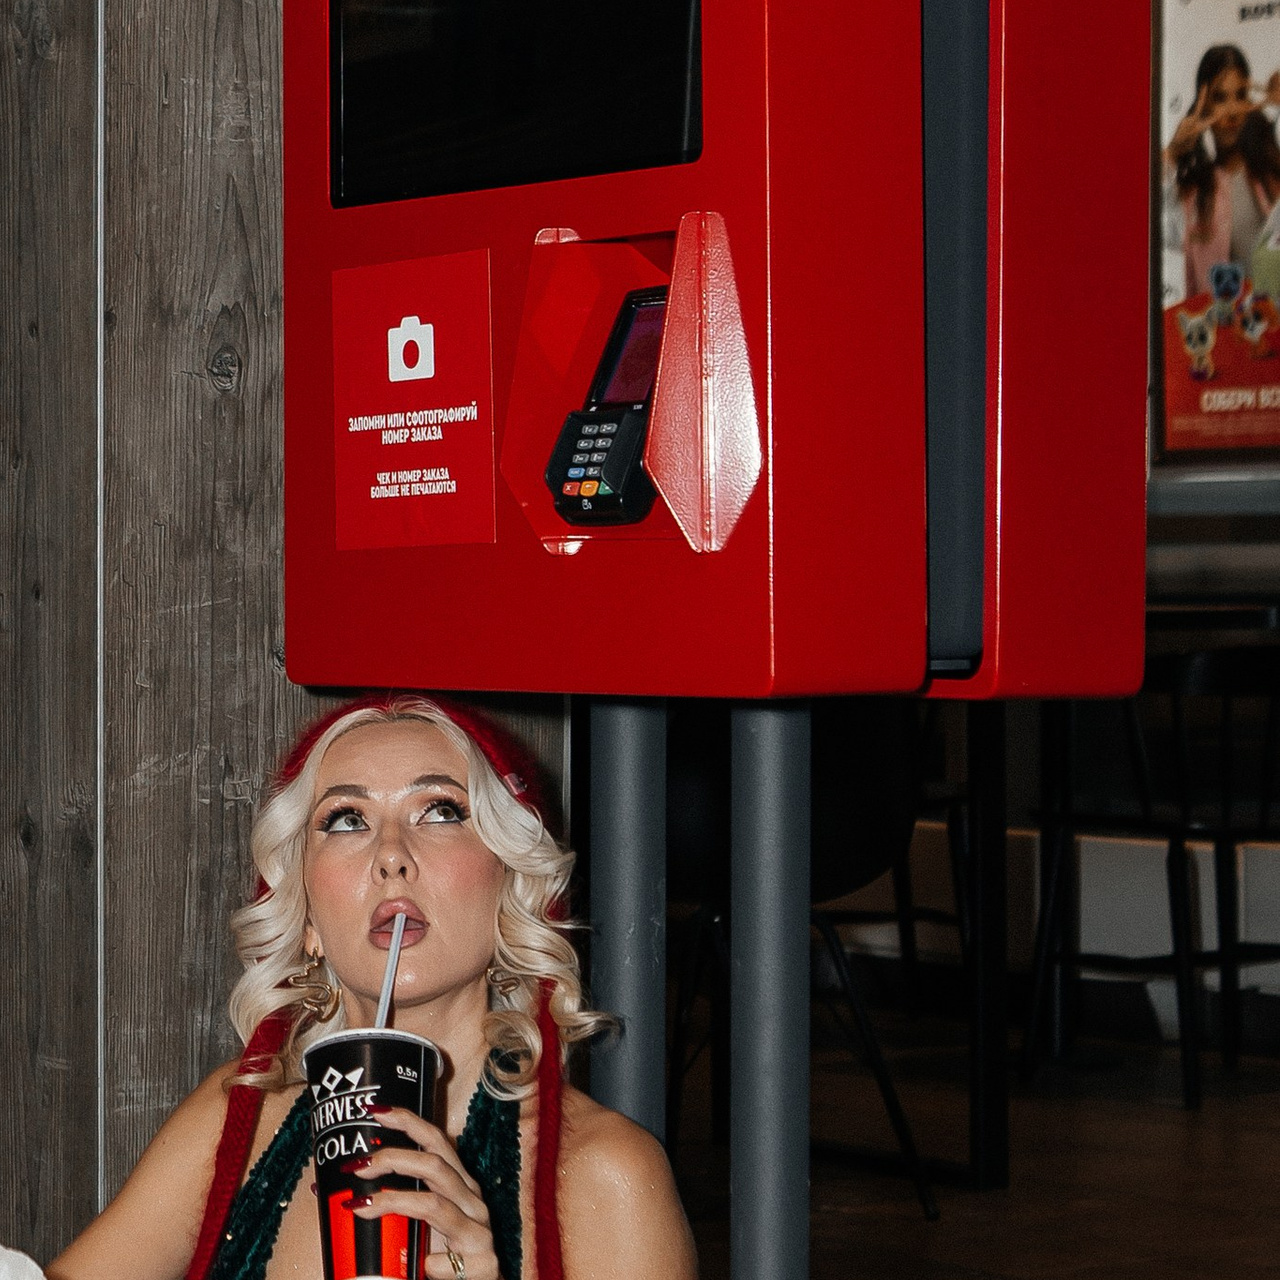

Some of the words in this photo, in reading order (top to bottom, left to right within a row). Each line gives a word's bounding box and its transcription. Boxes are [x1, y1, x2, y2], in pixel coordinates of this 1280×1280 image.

[348, 414, 386, 432] ЗАПОМНИ
[387, 413, 405, 428] ИЛИ
[406, 401, 478, 427] СФОТОГРАФИРУЙ
[381, 428, 410, 445] НОМЕР
[410, 425, 443, 442] ЗАКАЗА
[376, 472, 391, 485] ЧЕК
[391, 471, 398, 483] И
[398, 469, 422, 483] НОМЕР
[422, 467, 450, 481] ЗАКАЗА
[370, 485, 400, 499] БОЛЬШЕ
[401, 484, 411, 496] НЕ
[411, 480, 457, 495] ПЕЧАТАЮТСЯ
[317, 1130, 369, 1166] COLA
